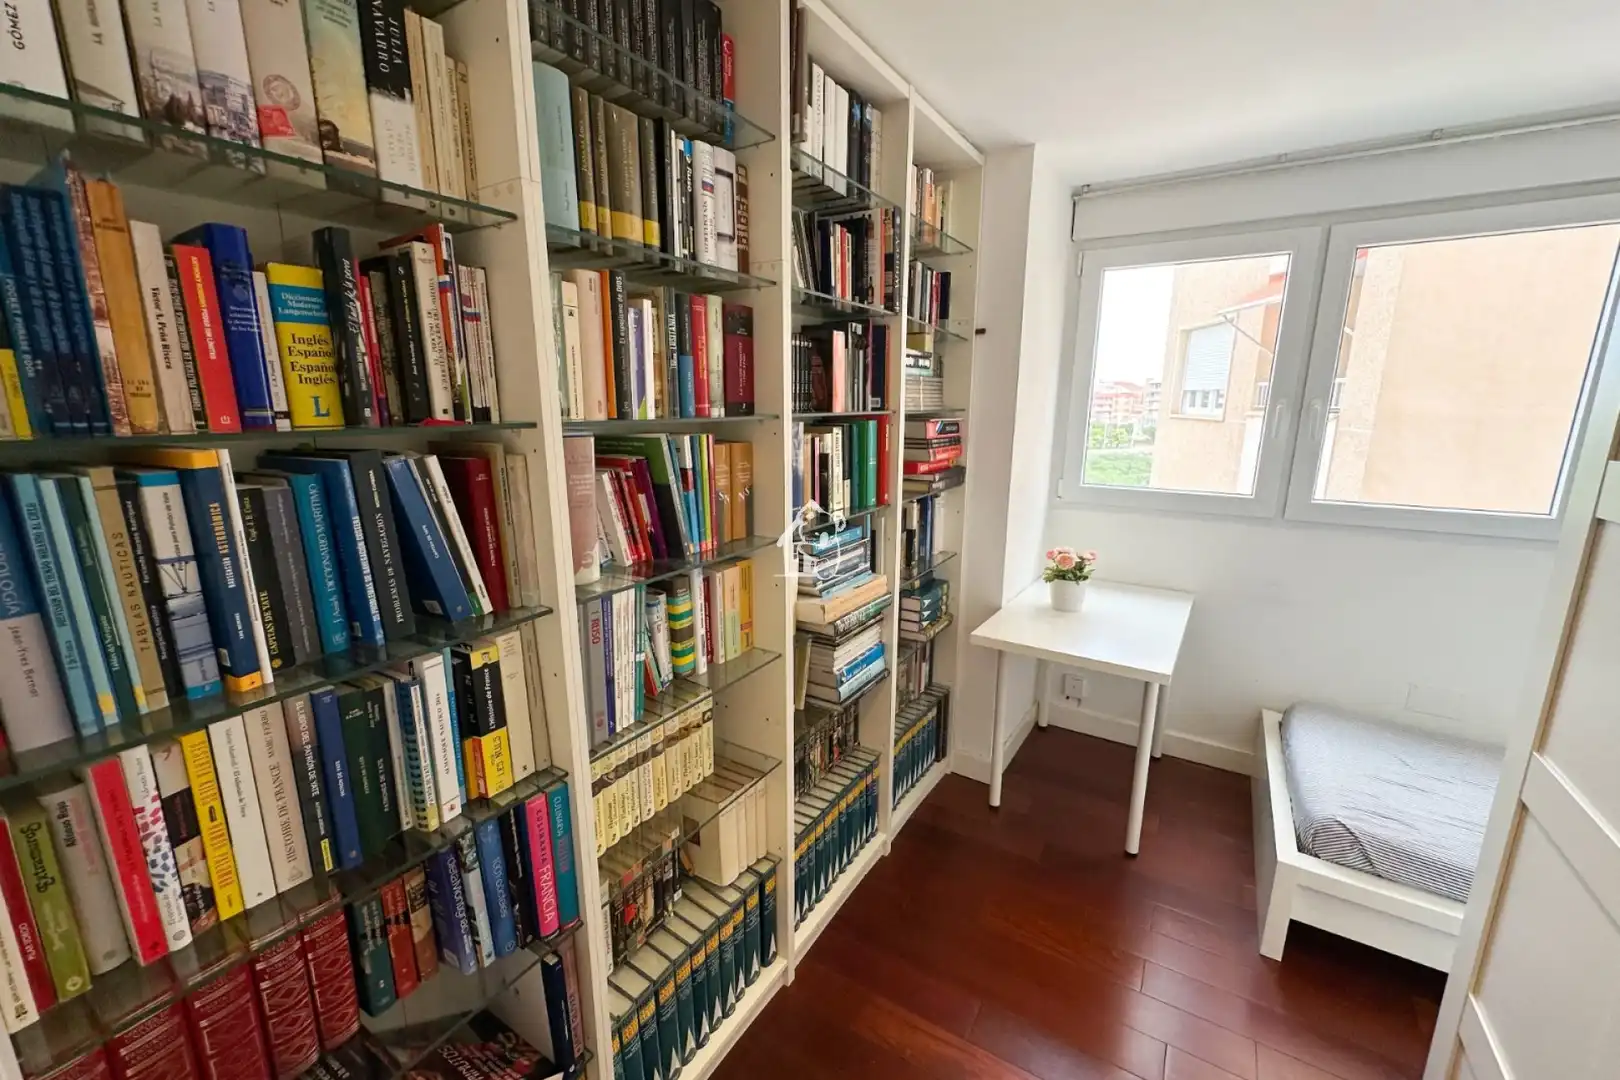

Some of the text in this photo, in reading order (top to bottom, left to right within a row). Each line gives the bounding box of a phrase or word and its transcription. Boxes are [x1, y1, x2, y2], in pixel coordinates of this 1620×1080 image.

[5, 2, 25, 50] GÓMEZ
[388, 17, 402, 64] JULIA
[5, 278, 34, 377] POCKET PHRASE BOOK
[156, 319, 169, 339] Peña
[291, 332, 330, 347] Inglés
[159, 341, 172, 369] Rivera
[297, 373, 336, 386] Inglés
[311, 396, 330, 418] L
[375, 512, 393, 568] NAVEGACION
[317, 532, 336, 591] DICCIONARIO
[111, 532, 150, 652] TABLAS NAUTICAS
[388, 581, 404, 622] PROBLEMAS
[258, 591, 279, 654] CAPITAN DE YATE
[592, 618, 601, 646] RUSO
[482, 669, 491, 688] France
[258, 709, 273, 736] FERRO
[300, 732, 311, 745] DEL
[302, 746, 316, 769] PATRÓN
[269, 763, 287, 801] FRANCE
[306, 771, 317, 780] DE
[308, 781, 319, 797] YATE
[276, 803, 290, 816] DE
[56, 801, 76, 847] Alfonso Rojo
[279, 817, 299, 863] HISTOIRE
[539, 864, 557, 922] FRANCIA
[18, 923, 33, 944] SORDO
